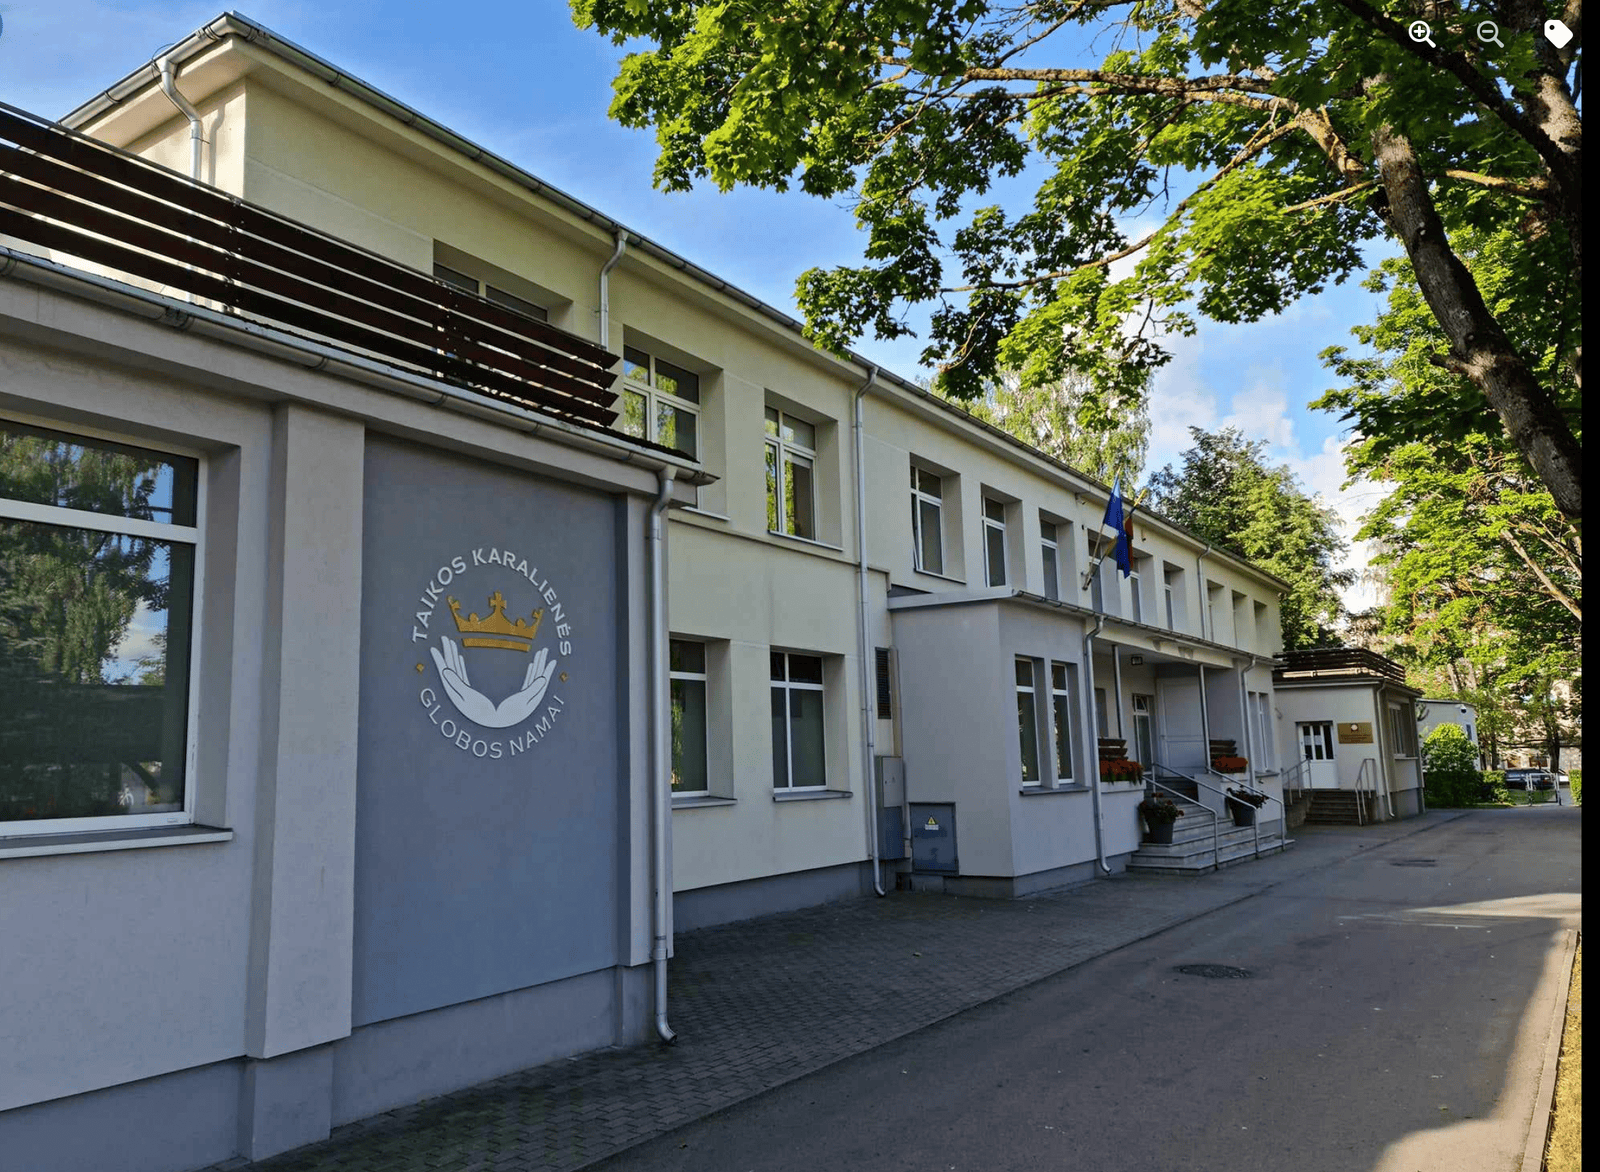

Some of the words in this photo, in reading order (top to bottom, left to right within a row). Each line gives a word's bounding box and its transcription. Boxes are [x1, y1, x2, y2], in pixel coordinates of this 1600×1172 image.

[411, 556, 467, 643] TAIKOS
[472, 548, 572, 656] KARALIENĖS
[420, 688, 503, 759] GLOBOS
[509, 695, 565, 756] NAMAI
